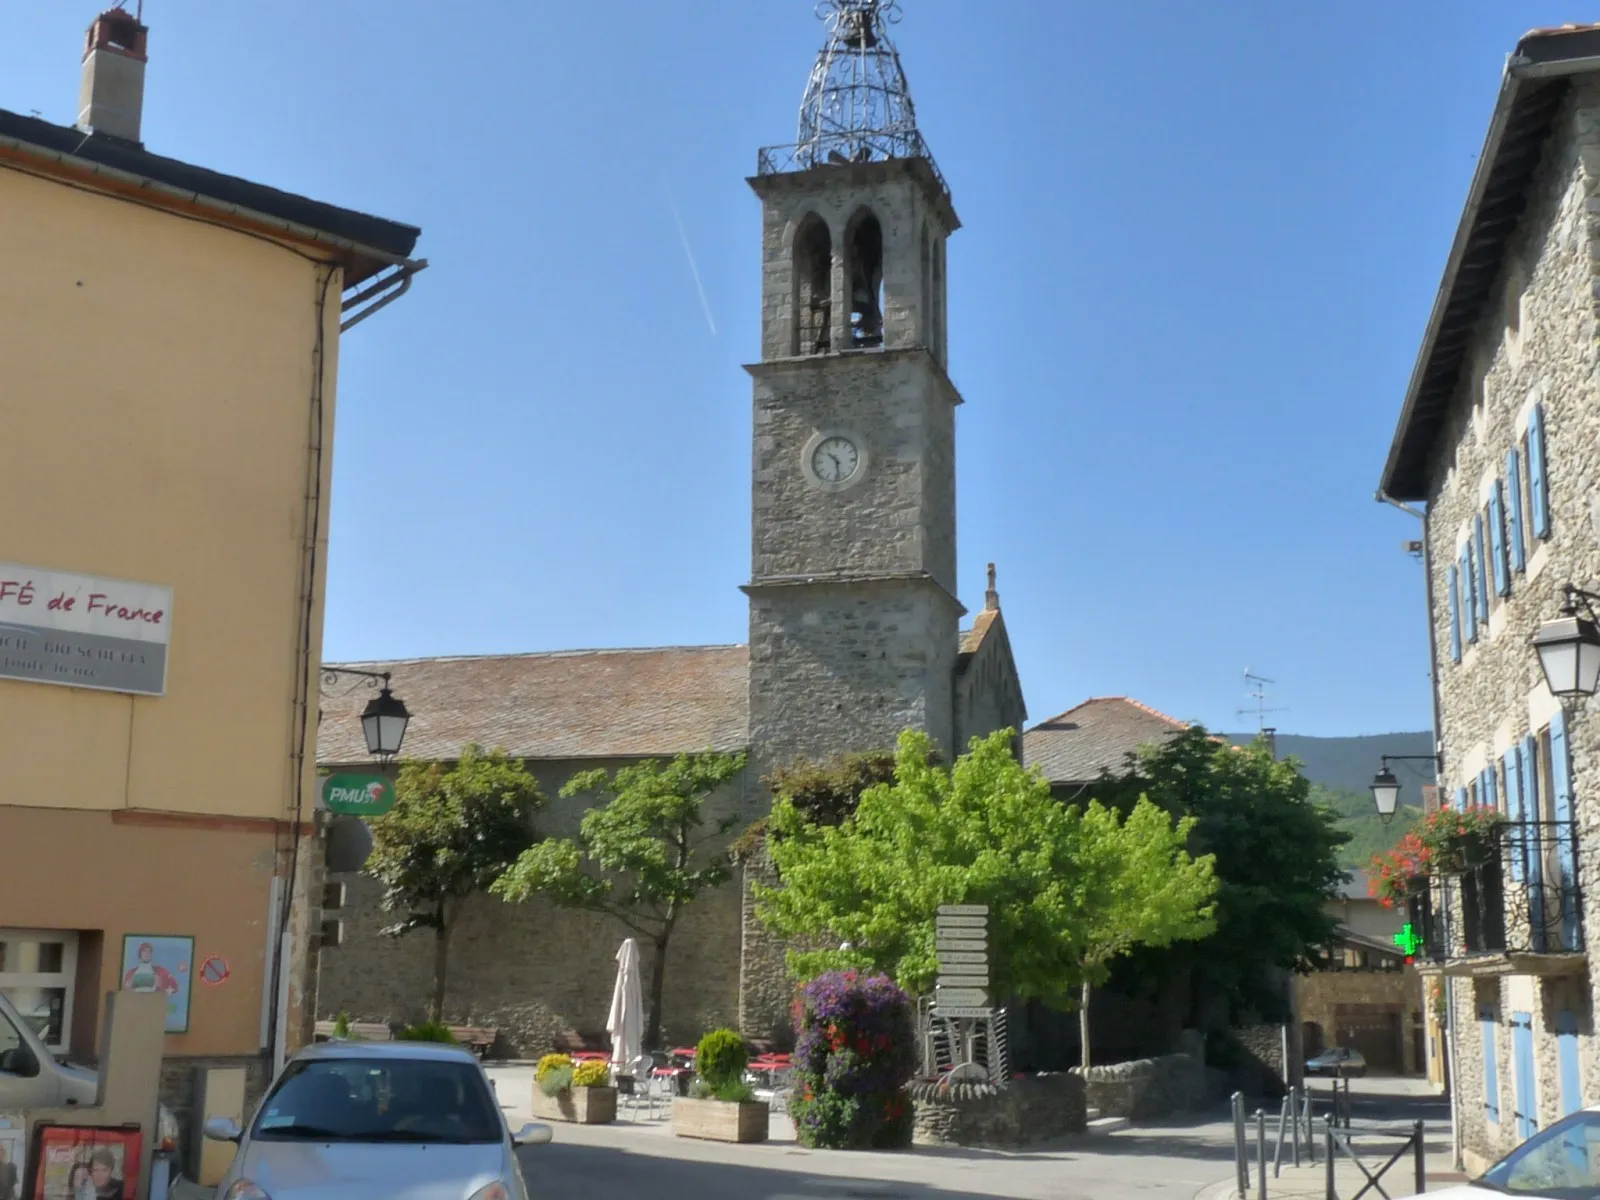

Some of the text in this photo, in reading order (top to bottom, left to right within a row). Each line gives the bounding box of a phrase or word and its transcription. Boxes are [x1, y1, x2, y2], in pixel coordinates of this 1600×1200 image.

[47, 592, 76, 611] de
[87, 594, 164, 624] France
[329, 787, 366, 804] PMU
